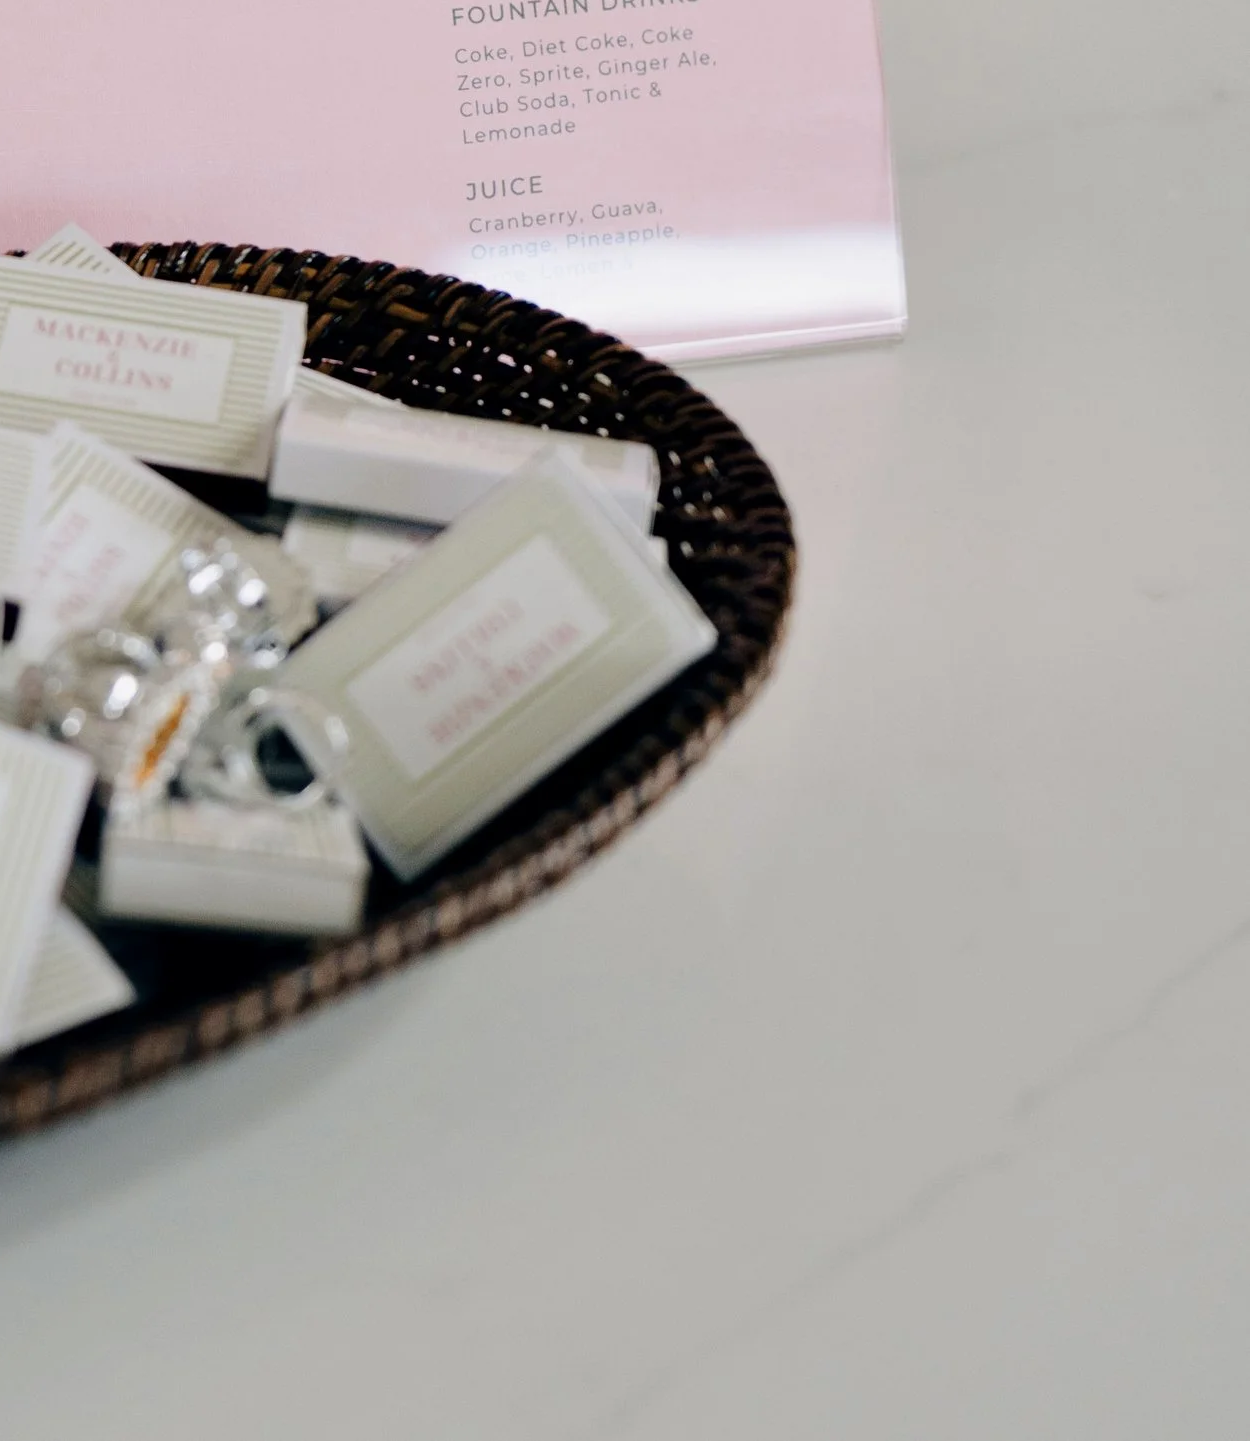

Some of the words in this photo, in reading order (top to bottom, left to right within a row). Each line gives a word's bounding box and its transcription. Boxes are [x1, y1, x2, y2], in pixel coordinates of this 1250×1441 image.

[455, 46, 513, 64] Coke,
[523, 40, 566, 57] Diet
[575, 33, 633, 51] Coke,
[642, 26, 693, 44] Coke
[457, 75, 511, 91] Zero,
[520, 65, 589, 86] Sprite,
[598, 58, 667, 75] Ginger
[678, 51, 716, 67] Ale,
[460, 98, 508, 117] Club
[518, 92, 575, 111] Soda,
[582, 87, 640, 104] Tonic
[649, 82, 661, 97] &
[463, 119, 575, 144] Lemonade
[467, 176, 542, 200] JUICE
[469, 210, 583, 233] Cranberry,
[592, 201, 662, 219] Guava,
[567, 223, 679, 248] Pineapple,
[34, 317, 196, 358] MACKENZIE
[54, 359, 173, 391] COLLINS
